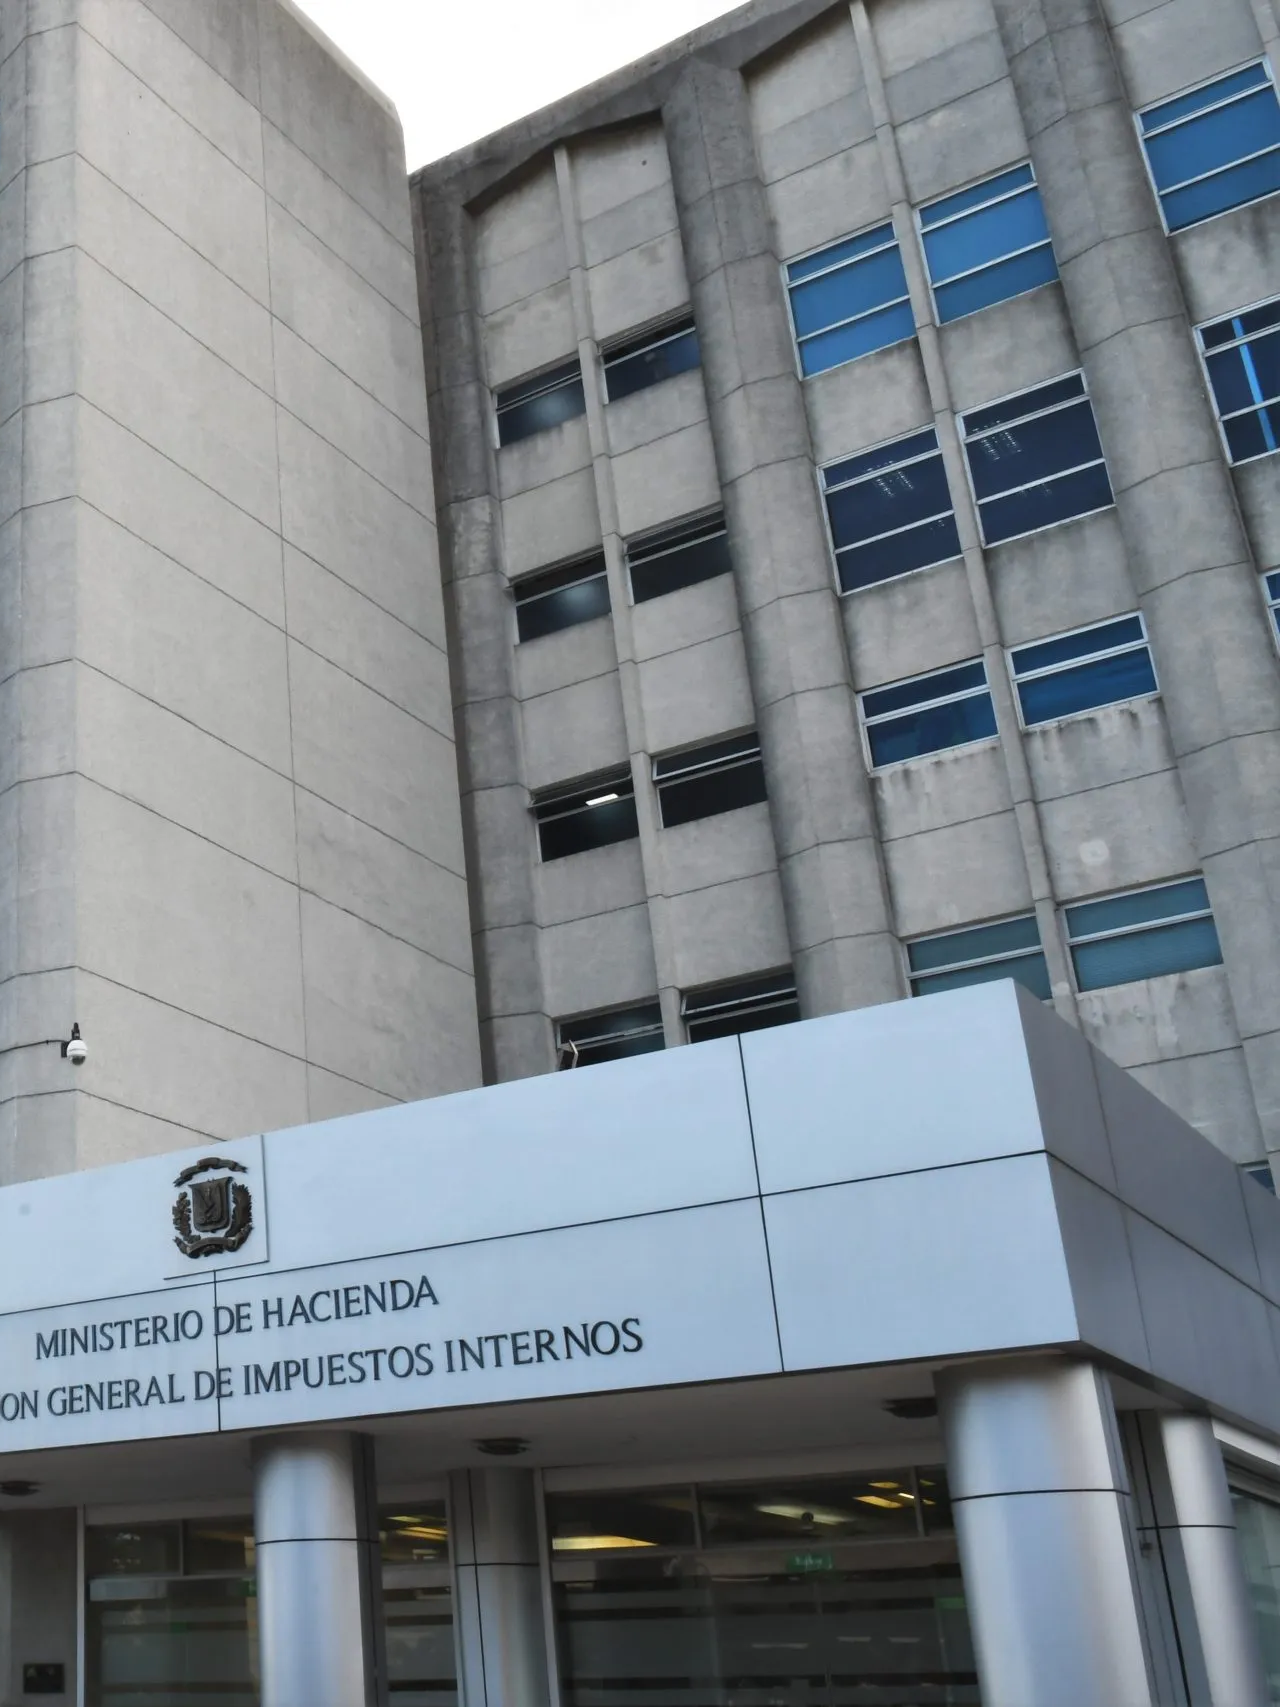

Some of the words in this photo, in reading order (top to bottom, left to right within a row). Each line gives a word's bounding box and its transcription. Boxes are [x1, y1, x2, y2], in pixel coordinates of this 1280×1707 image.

[35, 1309, 203, 1360] MINISTERIO
[214, 1302, 252, 1336] DE
[262, 1275, 439, 1329] HACIENDA
[47, 1373, 185, 1416] GENERAL
[194, 1364, 233, 1400] DE
[243, 1343, 434, 1395] IMPUESTOS
[445, 1317, 643, 1373] INTERNOS
